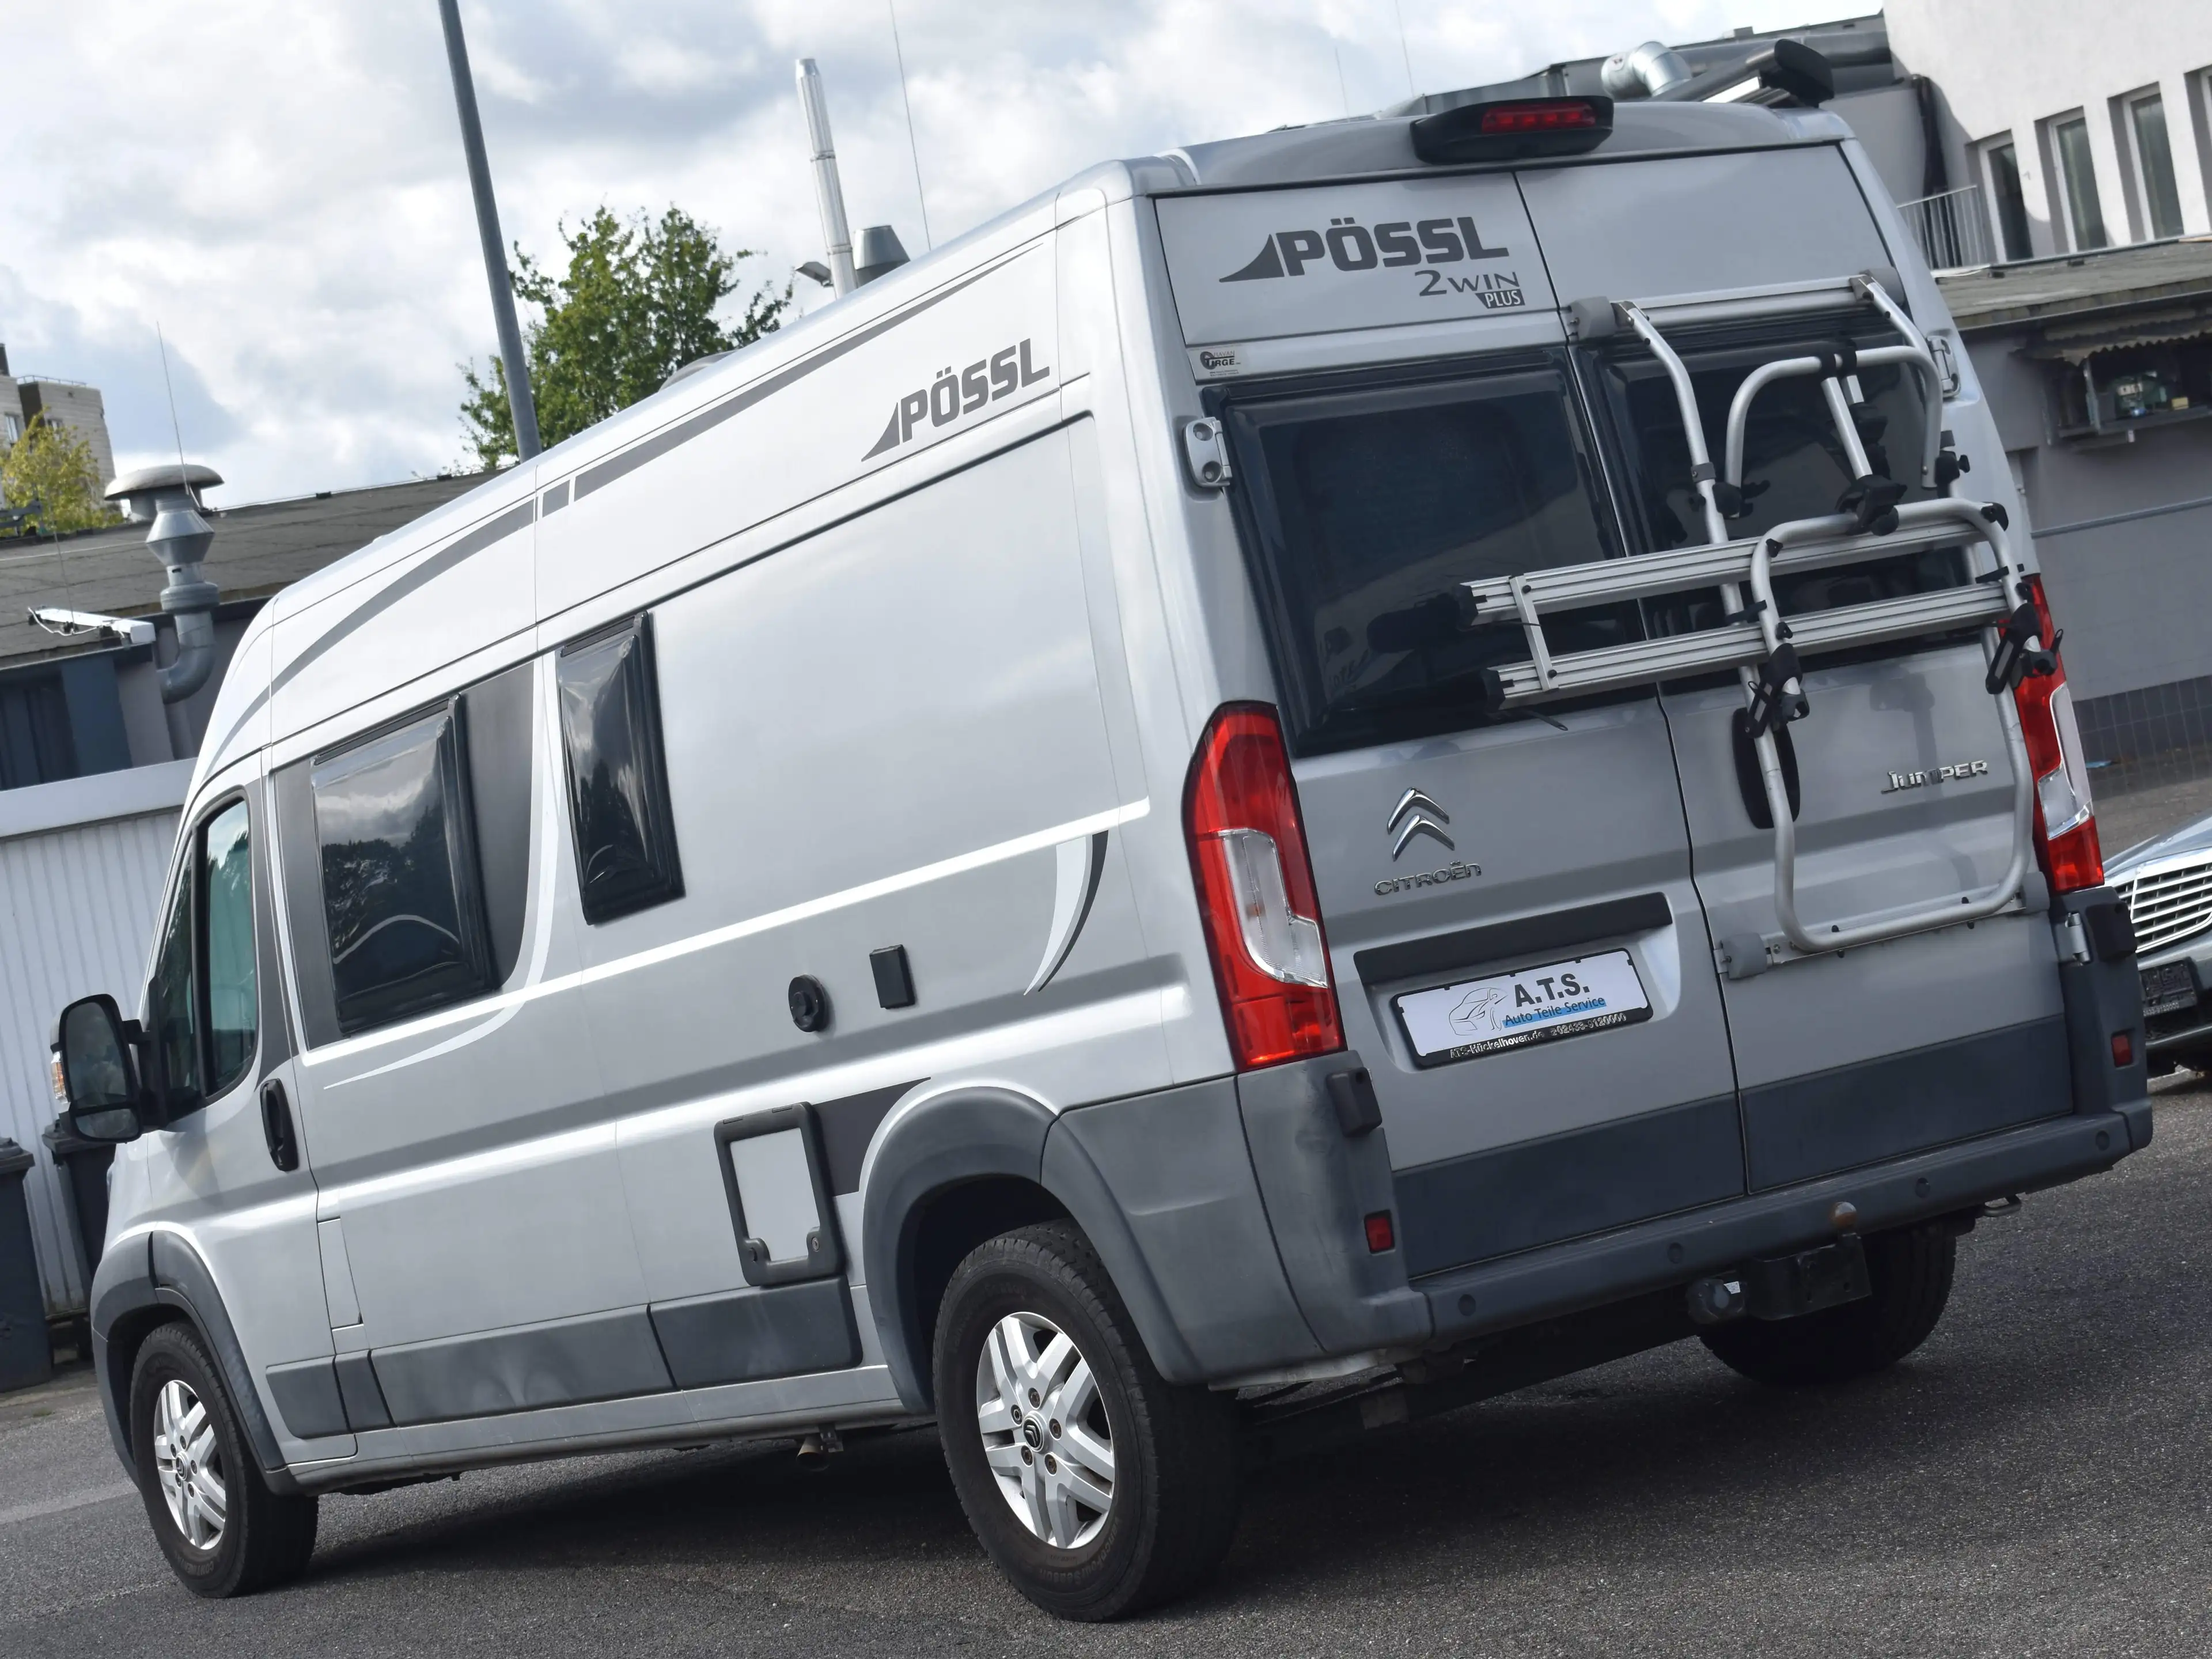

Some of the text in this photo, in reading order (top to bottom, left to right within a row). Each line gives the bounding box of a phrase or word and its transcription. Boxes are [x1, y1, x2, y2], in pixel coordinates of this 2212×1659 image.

[1276, 217, 1509, 276] PÖSSL
[1485, 290, 1521, 308] PLUS
[900, 338, 1050, 443] PÖSSL
[1374, 861, 1482, 895] CITROËN
[1514, 973, 1590, 1007] A.T.S.
[1505, 996, 1605, 1027] Auto Teile Service
